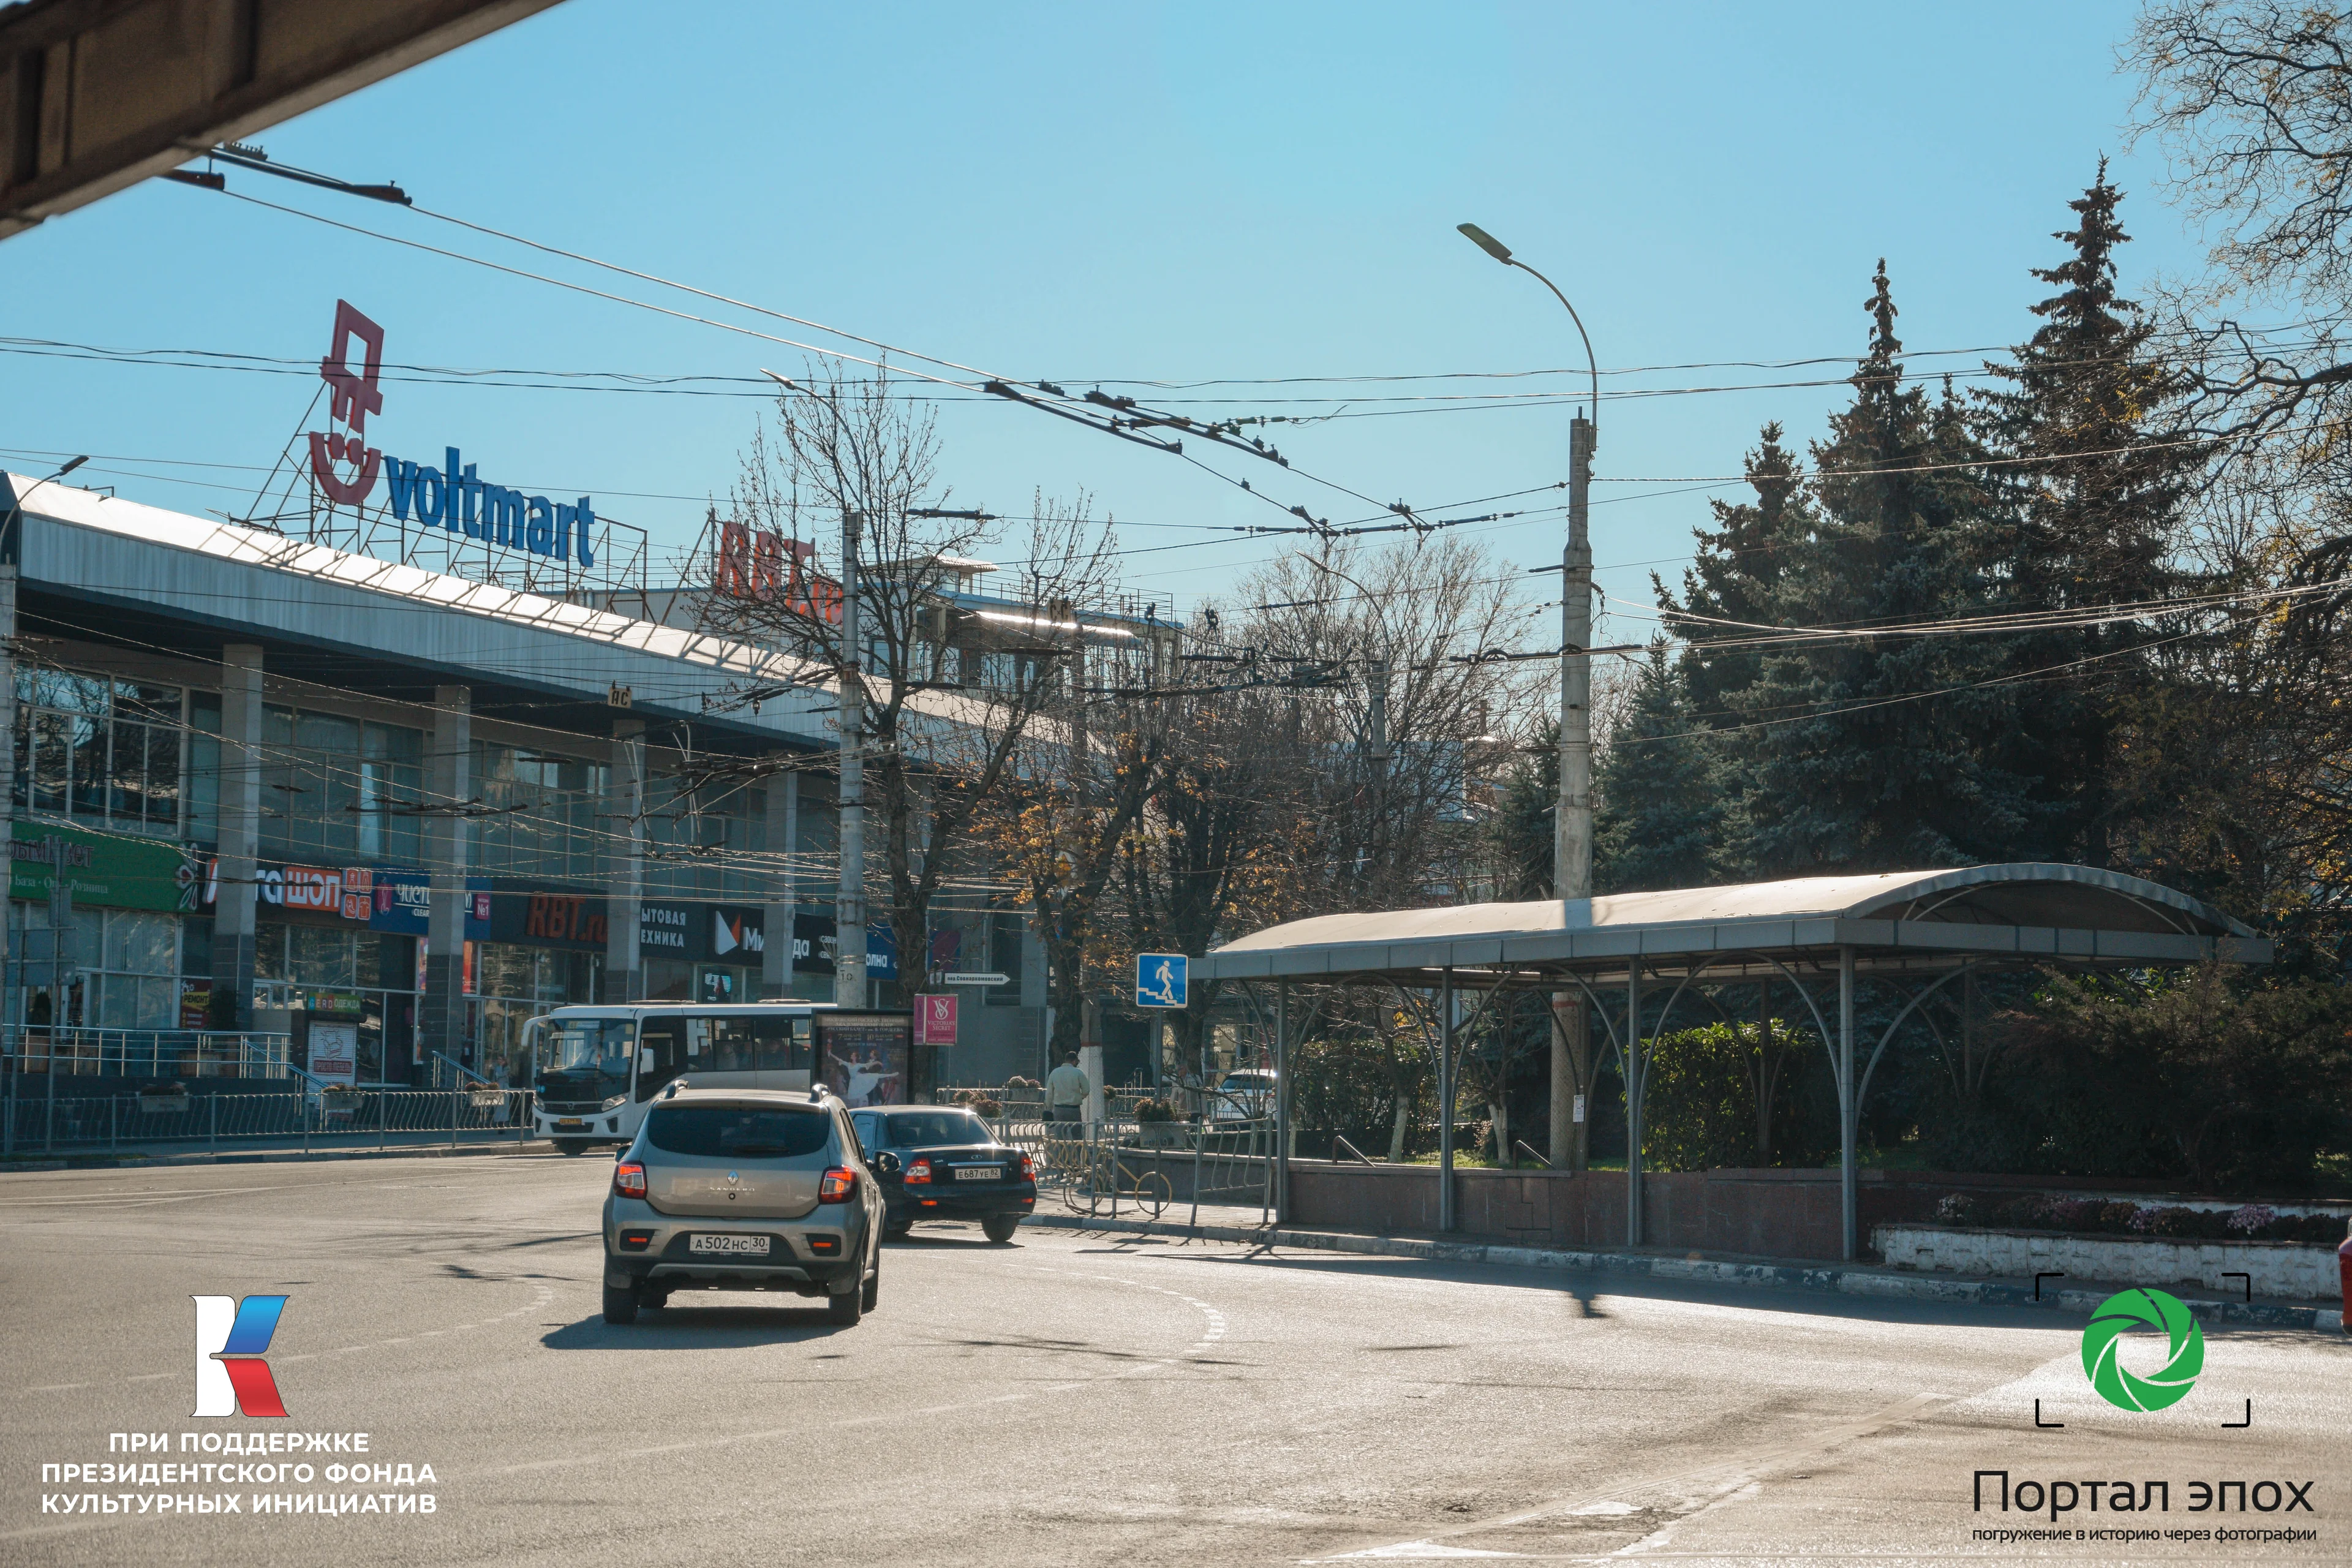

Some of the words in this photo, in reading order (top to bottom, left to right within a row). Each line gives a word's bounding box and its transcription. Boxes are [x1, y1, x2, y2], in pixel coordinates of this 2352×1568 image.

[384, 446, 595, 568] voltmart
[71, 879, 108, 894] Розница
[641, 908, 686, 926] ЫТОВАЯ
[641, 929, 684, 948] ЕХНИКА
[865, 953, 888, 968] олна
[334, 999, 360, 1009] ОДЕЖДА
[752, 1237, 765, 1247] 30
